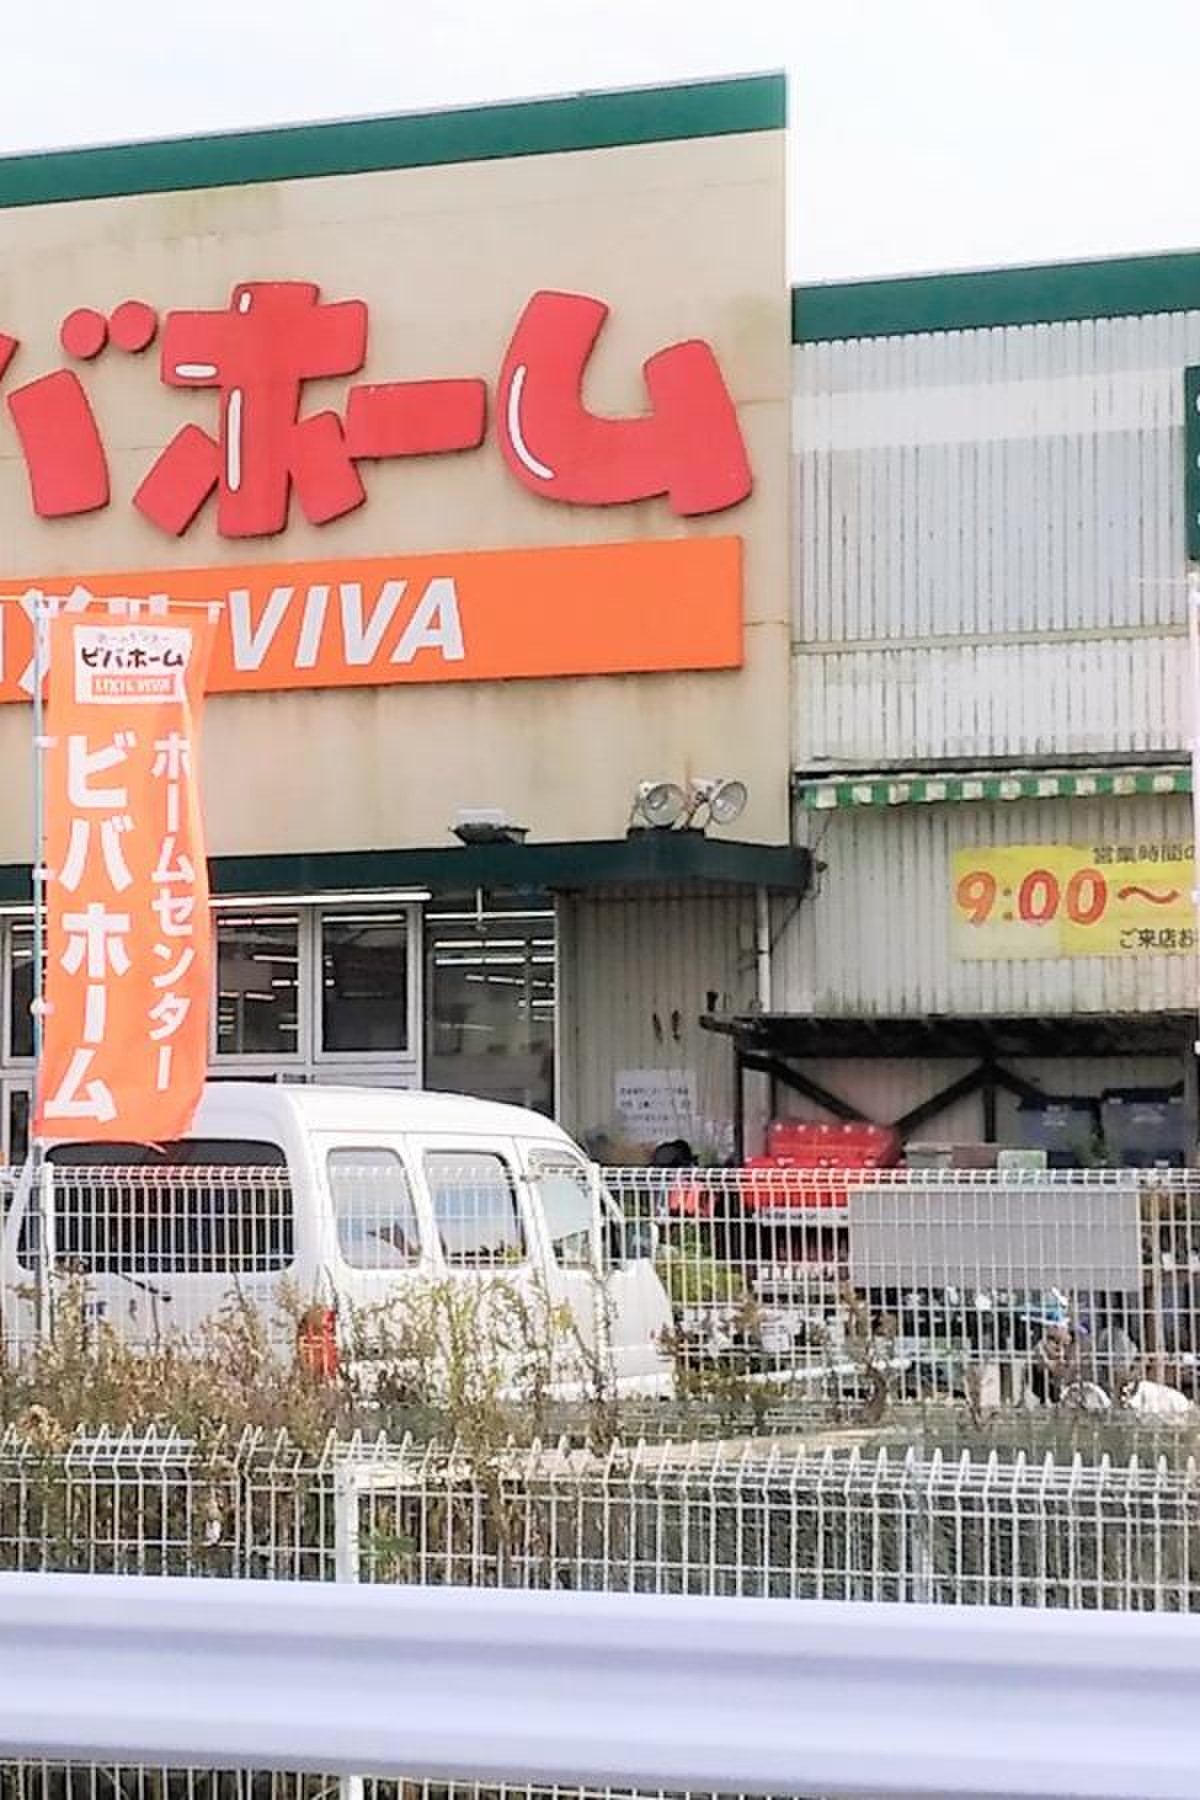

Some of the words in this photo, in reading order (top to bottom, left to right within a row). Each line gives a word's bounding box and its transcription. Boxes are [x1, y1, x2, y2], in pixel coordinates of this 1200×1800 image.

[81, 647, 185, 669] ビバホーム
[228, 577, 465, 672] VIVA
[44, 731, 138, 1122] ビバホーム
[149, 731, 195, 1090] ホームセンター
